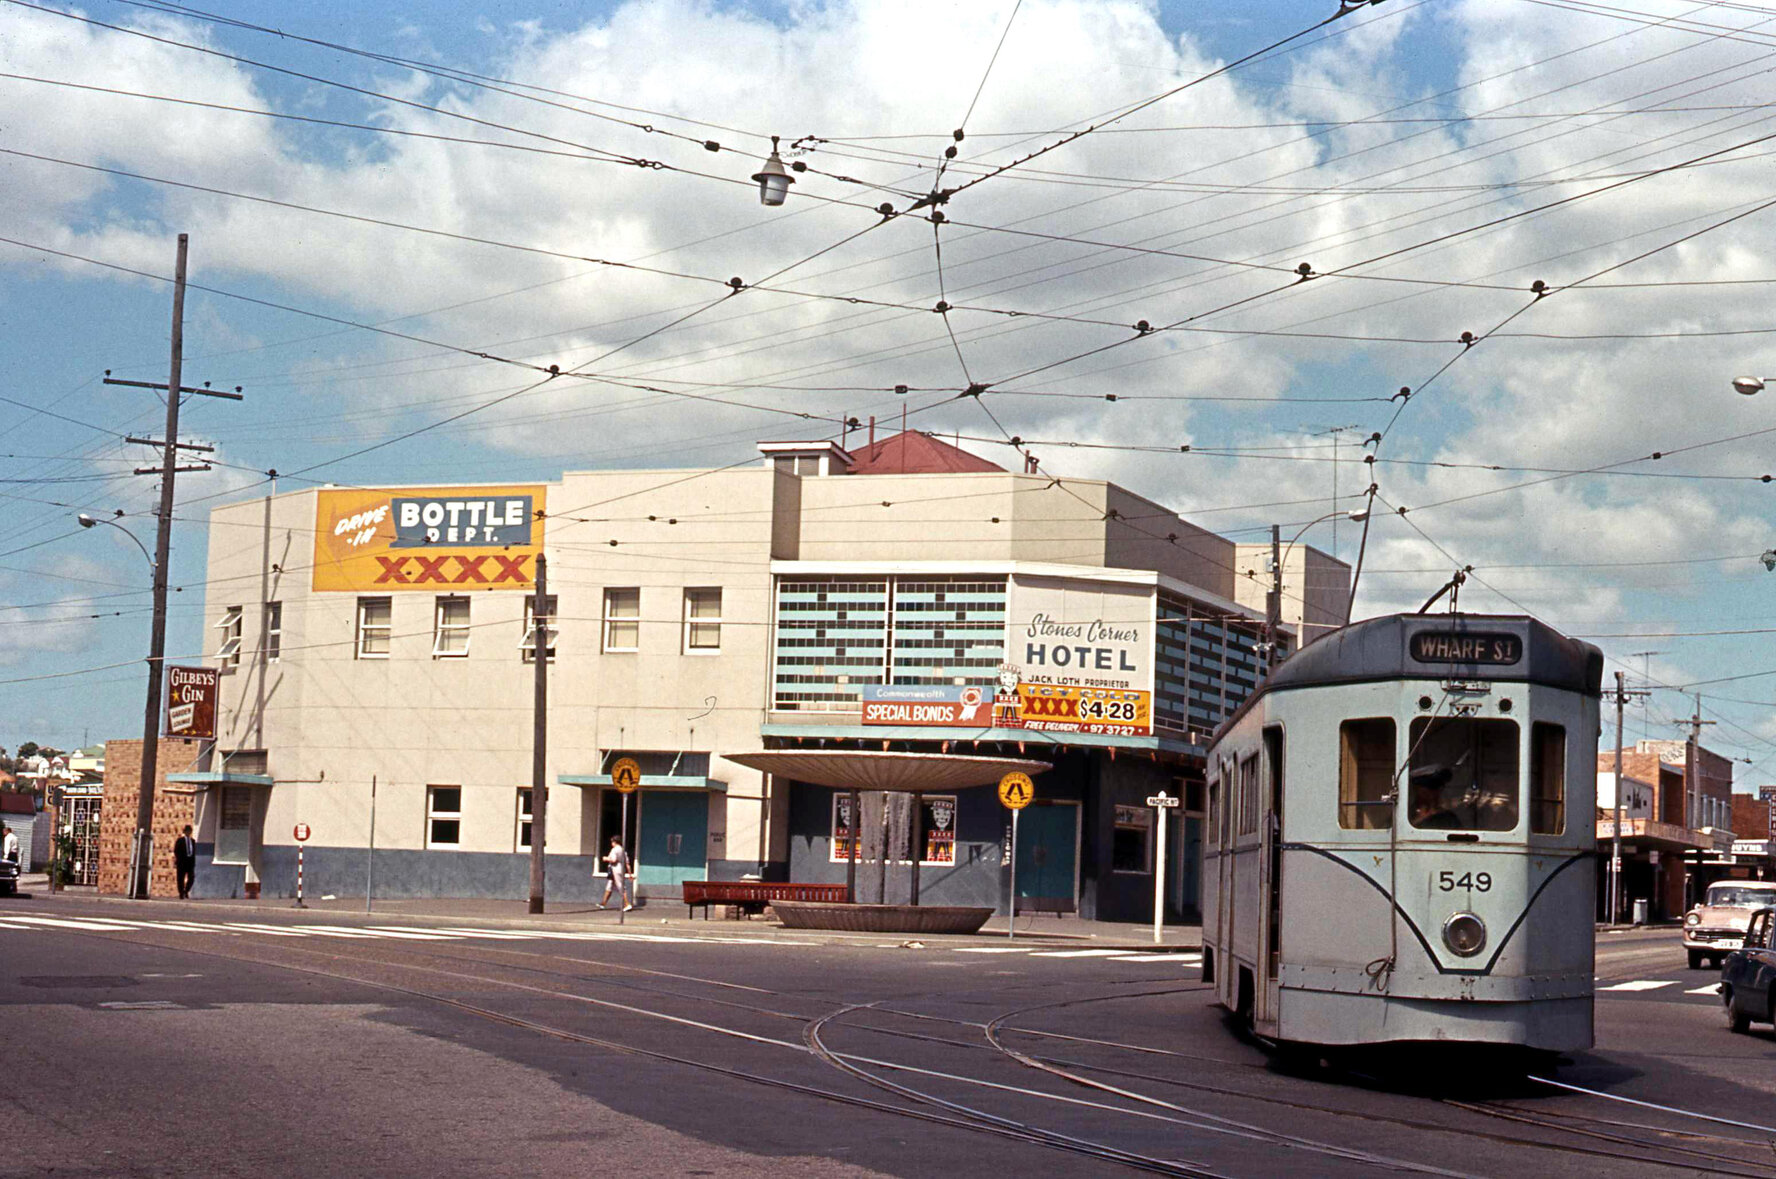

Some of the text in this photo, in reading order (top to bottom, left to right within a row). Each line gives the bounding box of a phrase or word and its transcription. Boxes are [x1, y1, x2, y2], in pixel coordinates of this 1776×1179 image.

[334, 505, 389, 536] DRIVE
[401, 501, 524, 527] BOTTLE
[427, 527, 498, 542] DEPT.
[373, 555, 532, 583] XXXX
[1027, 613, 1139, 643] Stones Corner
[1026, 642, 1136, 672] HOTEL
[1420, 637, 1485, 659] WHARF
[171, 668, 215, 687] GILBEY'S
[1028, 675, 1129, 688] JACK LOTH PROPRIETOR
[182, 685, 204, 703] GIN
[876, 688, 945, 698] Commonwealth
[1028, 686, 1140, 700] ICY COLD
[866, 705, 954, 722] SPECIAL BONDS
[1023, 696, 1079, 717] XXXX
[1024, 720, 1043, 730] FREE
[1439, 871, 1492, 892] 549
